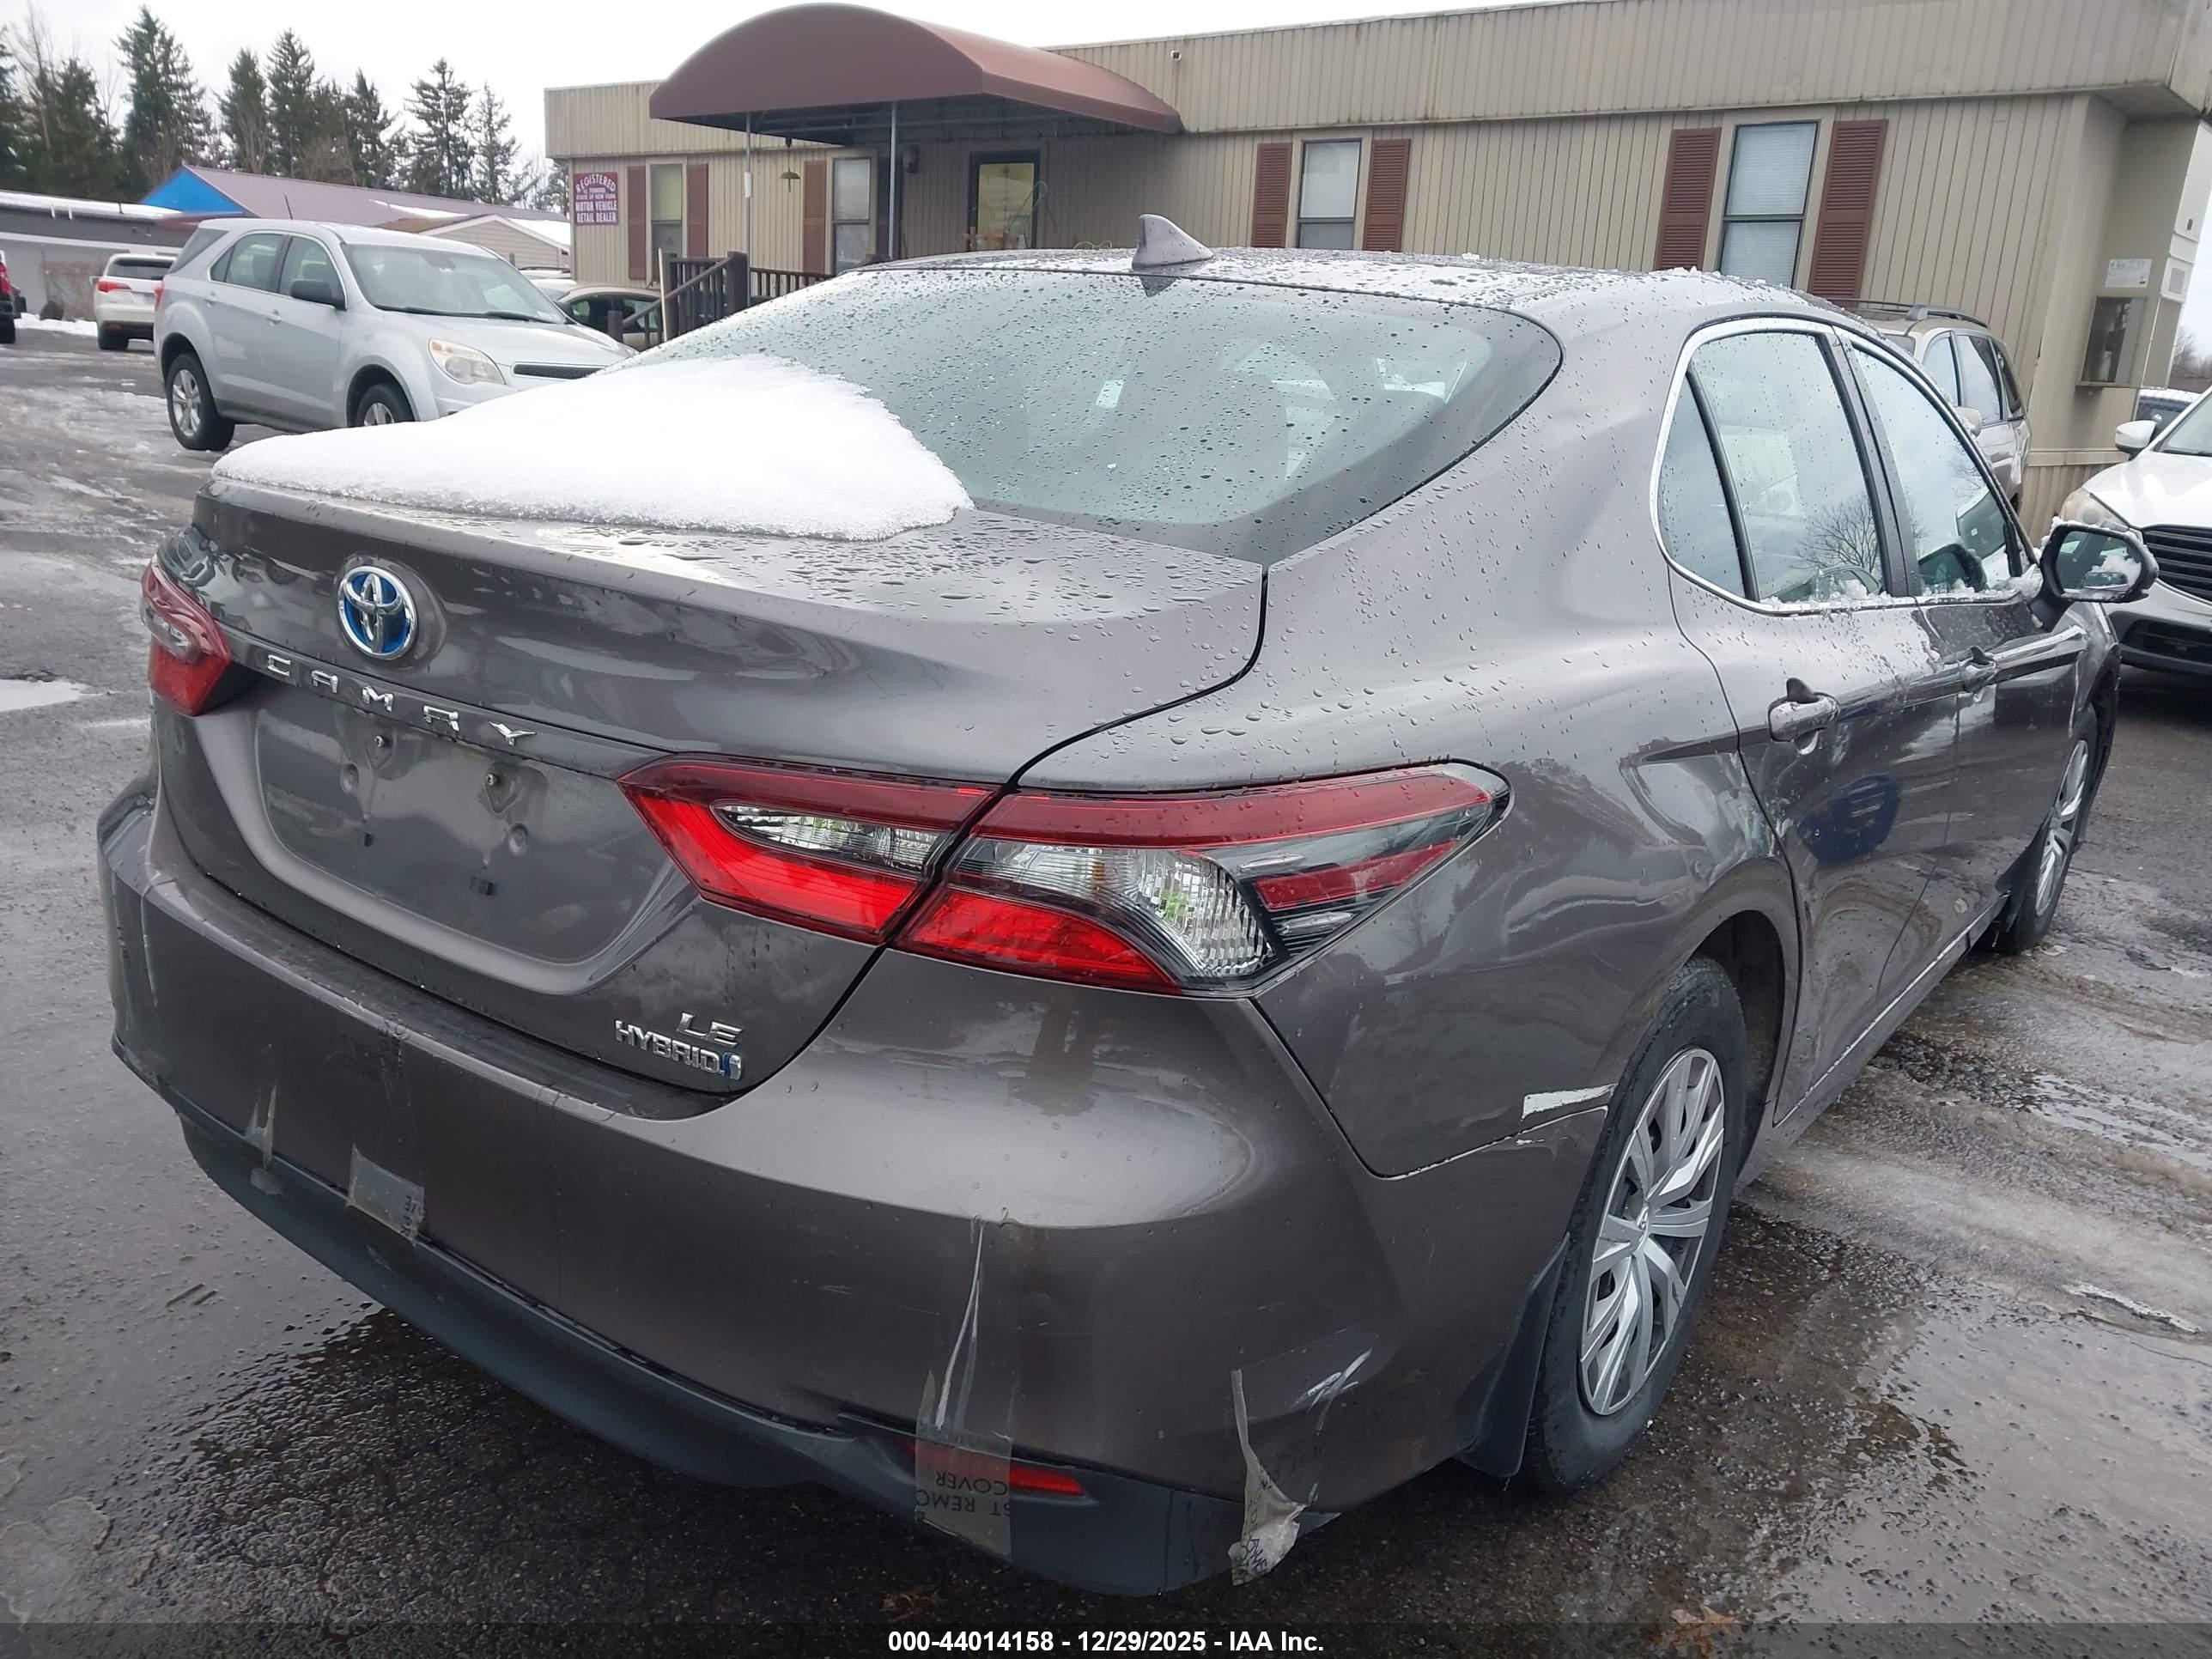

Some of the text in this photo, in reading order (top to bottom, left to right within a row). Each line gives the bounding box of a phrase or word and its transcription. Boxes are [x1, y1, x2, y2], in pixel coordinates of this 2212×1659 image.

[575, 173, 616, 193] REGISTERED
[575, 200, 617, 211] MOTOR VEHICLE
[576, 211, 617, 223] RETAIL DEALER
[266, 653, 538, 746] CAMRY
[676, 1012, 744, 1048] LE
[615, 1019, 720, 1074] HYBRID
[935, 1470, 1008, 1496] COVER
